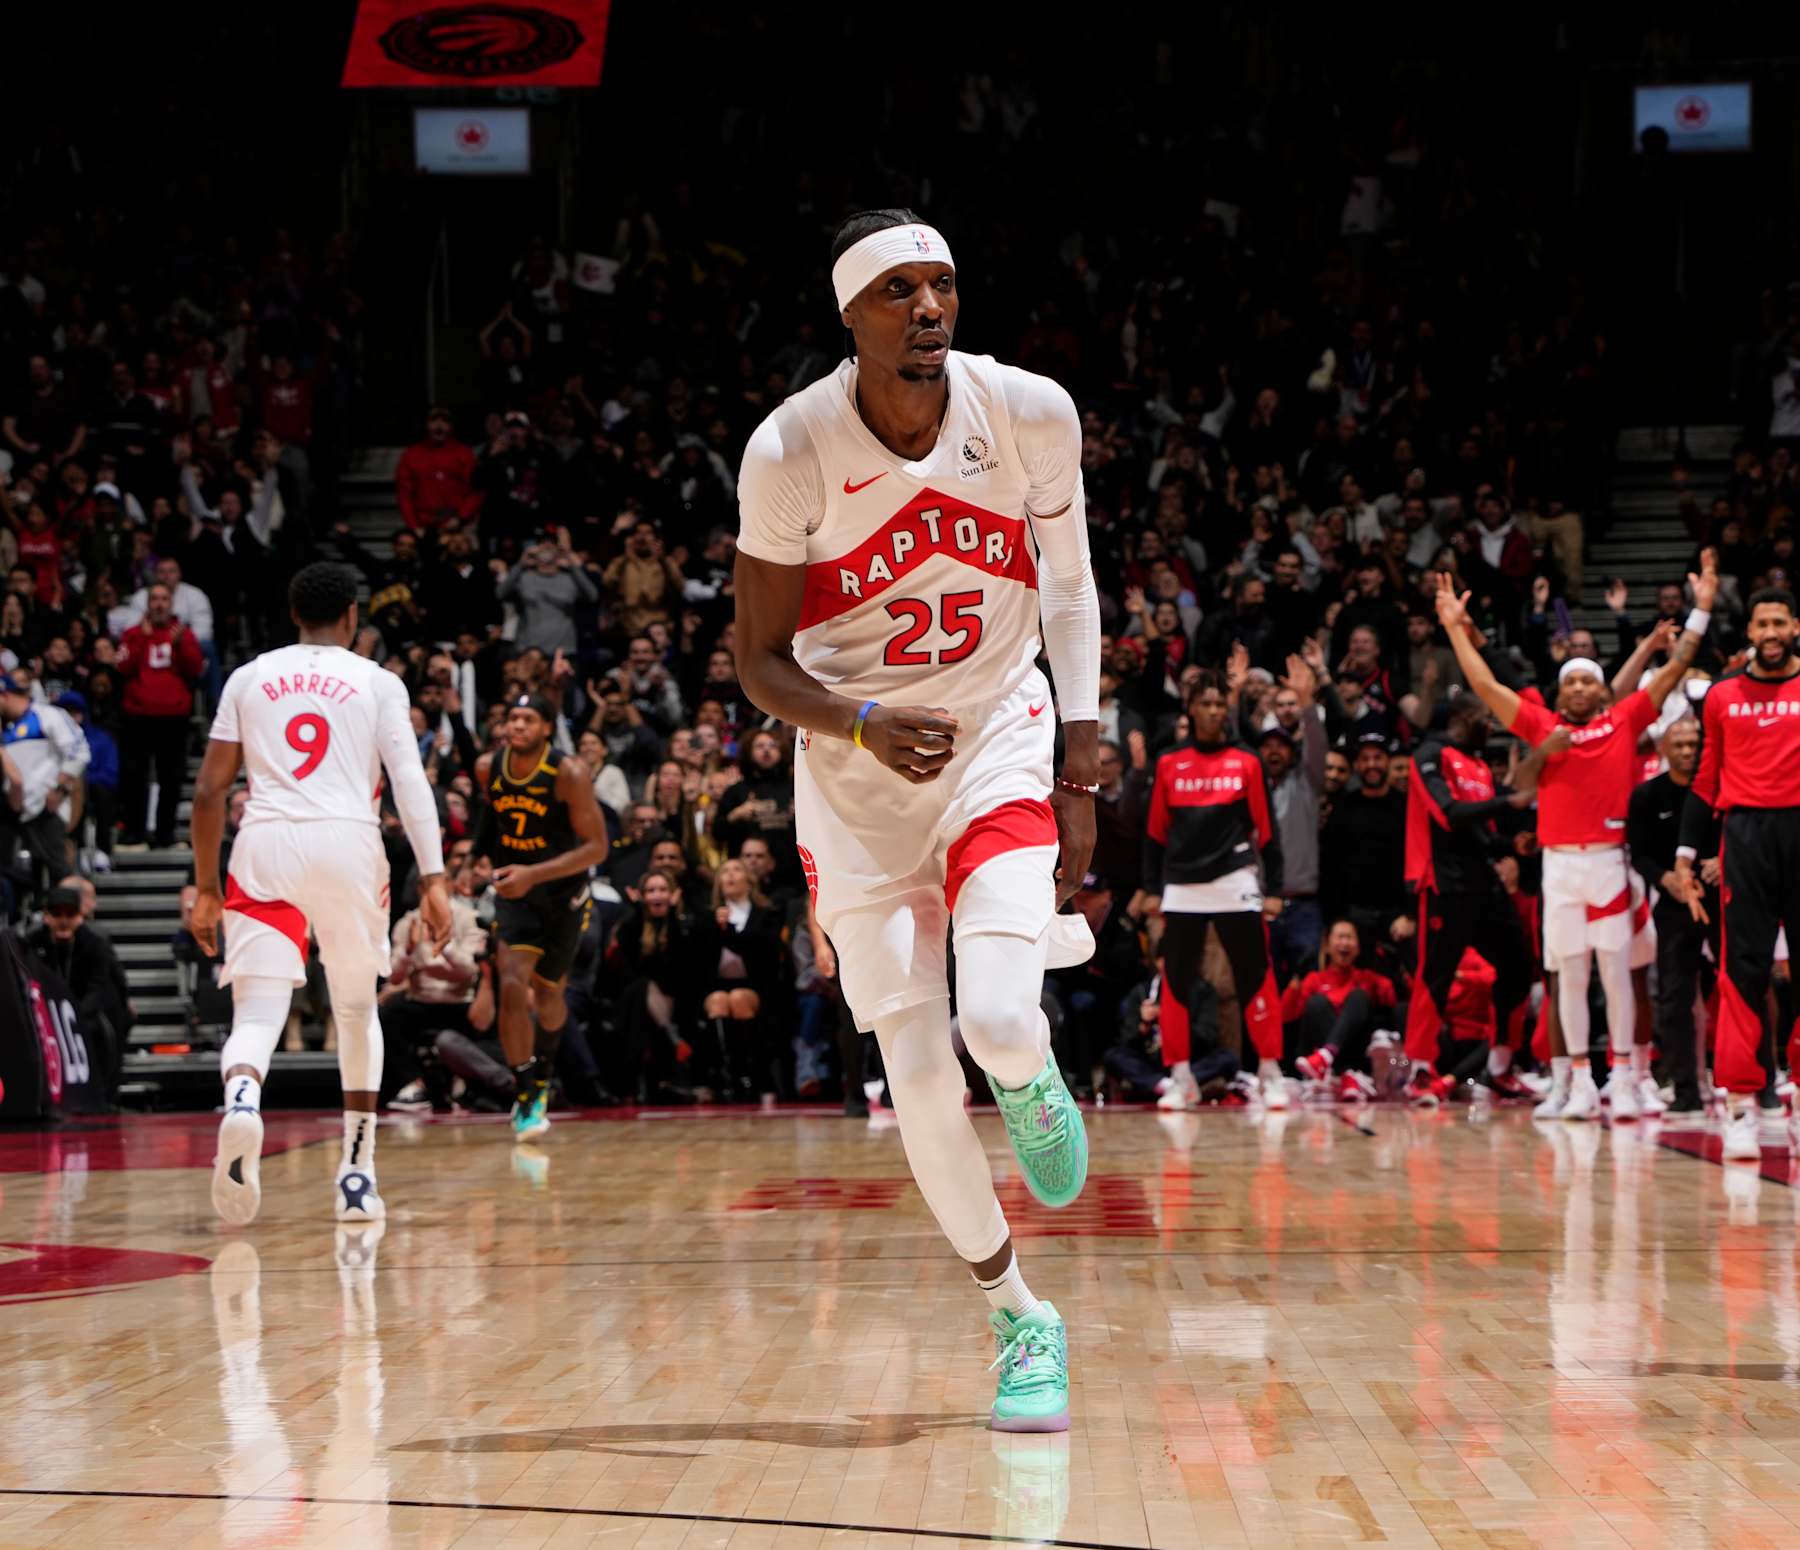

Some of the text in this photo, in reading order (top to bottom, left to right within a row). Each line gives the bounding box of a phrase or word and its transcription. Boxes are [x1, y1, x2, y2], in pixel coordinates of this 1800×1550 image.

[960, 459, 999, 479] Sun Life
[883, 588, 984, 666] 25
[261, 672, 360, 705] BARRETT
[285, 711, 331, 781] 9
[493, 794, 549, 817] GOLDEN
[510, 811, 528, 837] 7
[501, 833, 547, 852] STATE
